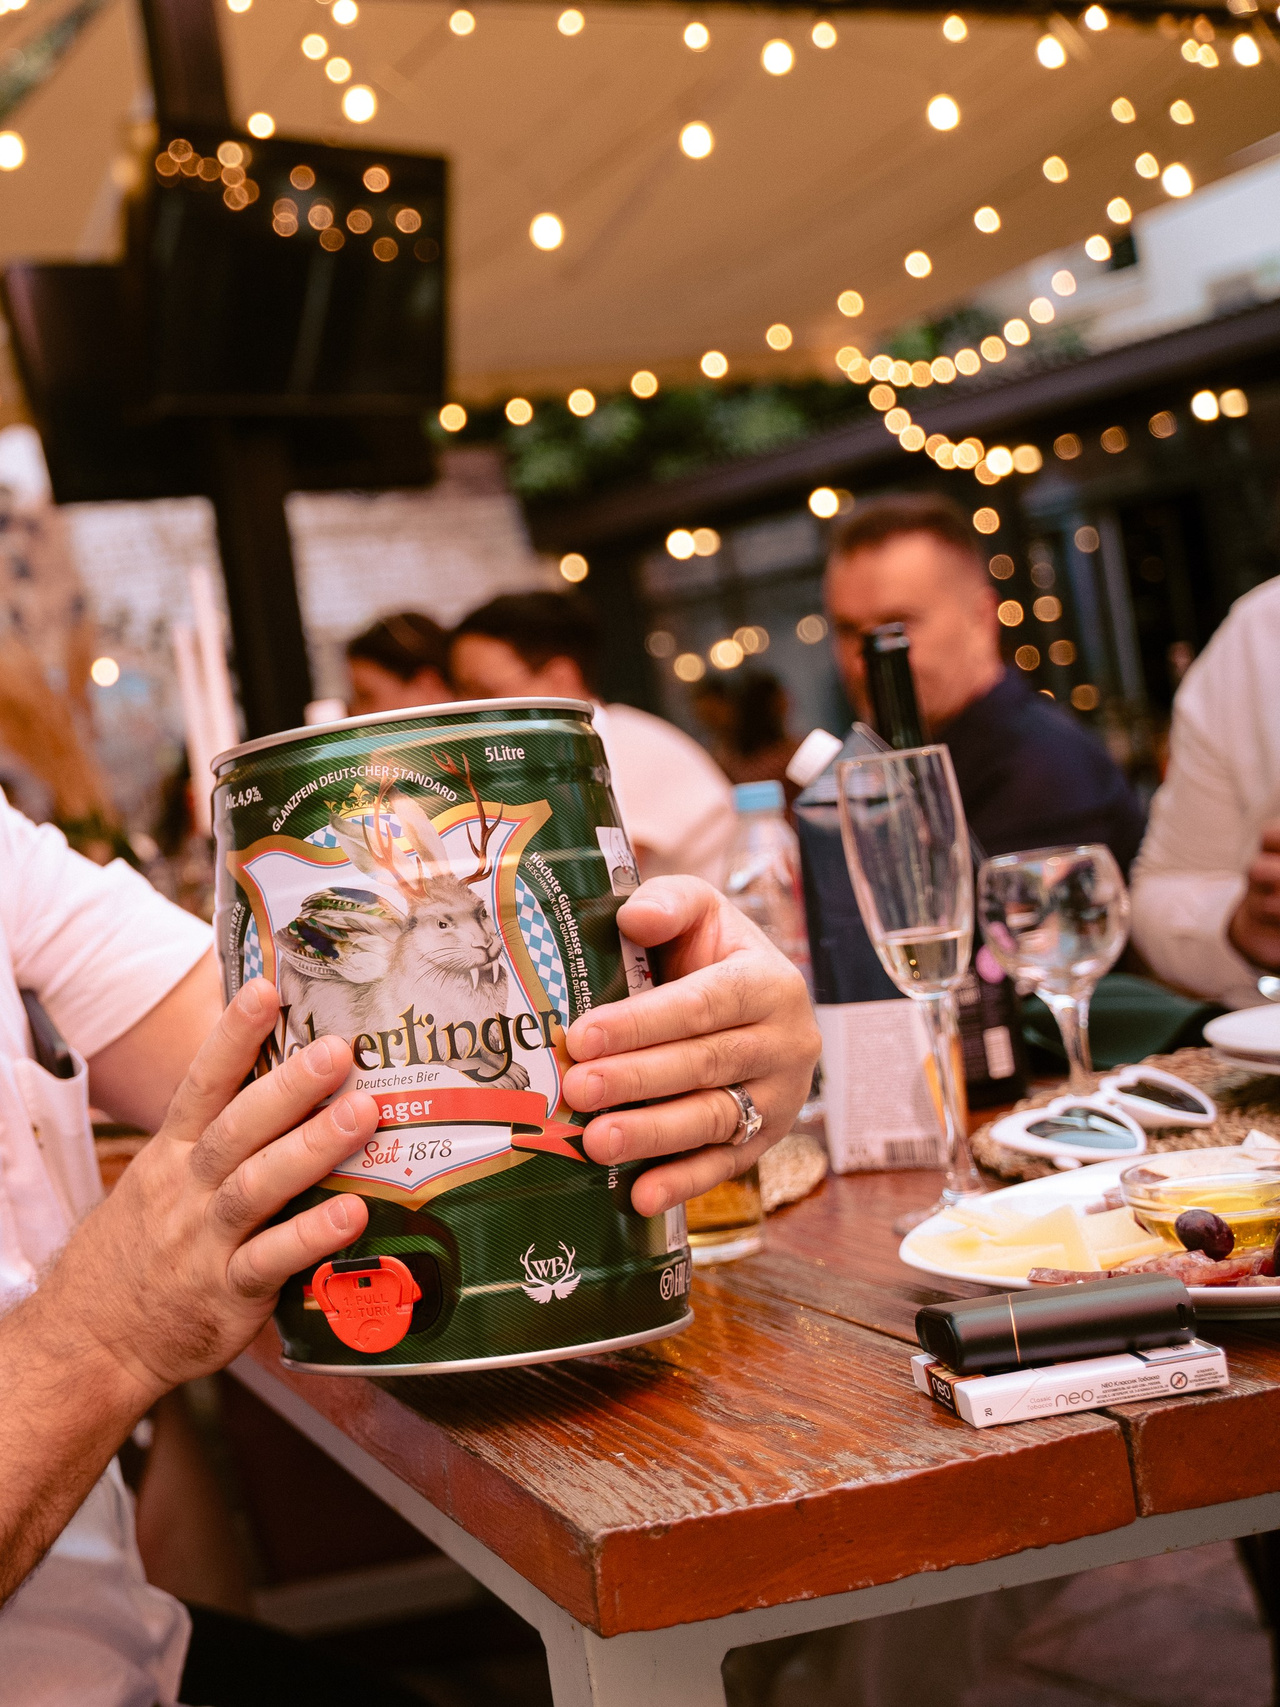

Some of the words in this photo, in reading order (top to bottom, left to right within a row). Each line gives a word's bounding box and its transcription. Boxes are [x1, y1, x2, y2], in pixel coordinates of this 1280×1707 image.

[272, 780, 319, 832] GLANZFEIN
[319, 765, 390, 788] DEUTSCHER
[392, 766, 458, 802] STANDARD
[230, 901, 242, 929] 1878
[524, 861, 557, 904] GESCHMACK
[552, 904, 563, 922] UND
[559, 923, 575, 960] QUALITÄT
[569, 961, 578, 978] AUS
[529, 851, 562, 894] Höchste
[558, 893, 583, 955] Güteklasse
[575, 957, 588, 978] mit
[355, 1074, 413, 1090] Deutsches
[416, 1070, 440, 1083] Bier
[379, 1099, 433, 1122] ager
[361, 1138, 403, 1169] Seit
[408, 1138, 452, 1161] 1878
[530, 1256, 567, 1279] WB
[355, 1293, 389, 1307] PULL
[358, 1305, 391, 1318] TURN
[931, 1376, 952, 1400] neo
[1055, 1389, 1094, 1408] neo
[1029, 1396, 1052, 1404] Classic
[984, 1407, 993, 1417] 20
